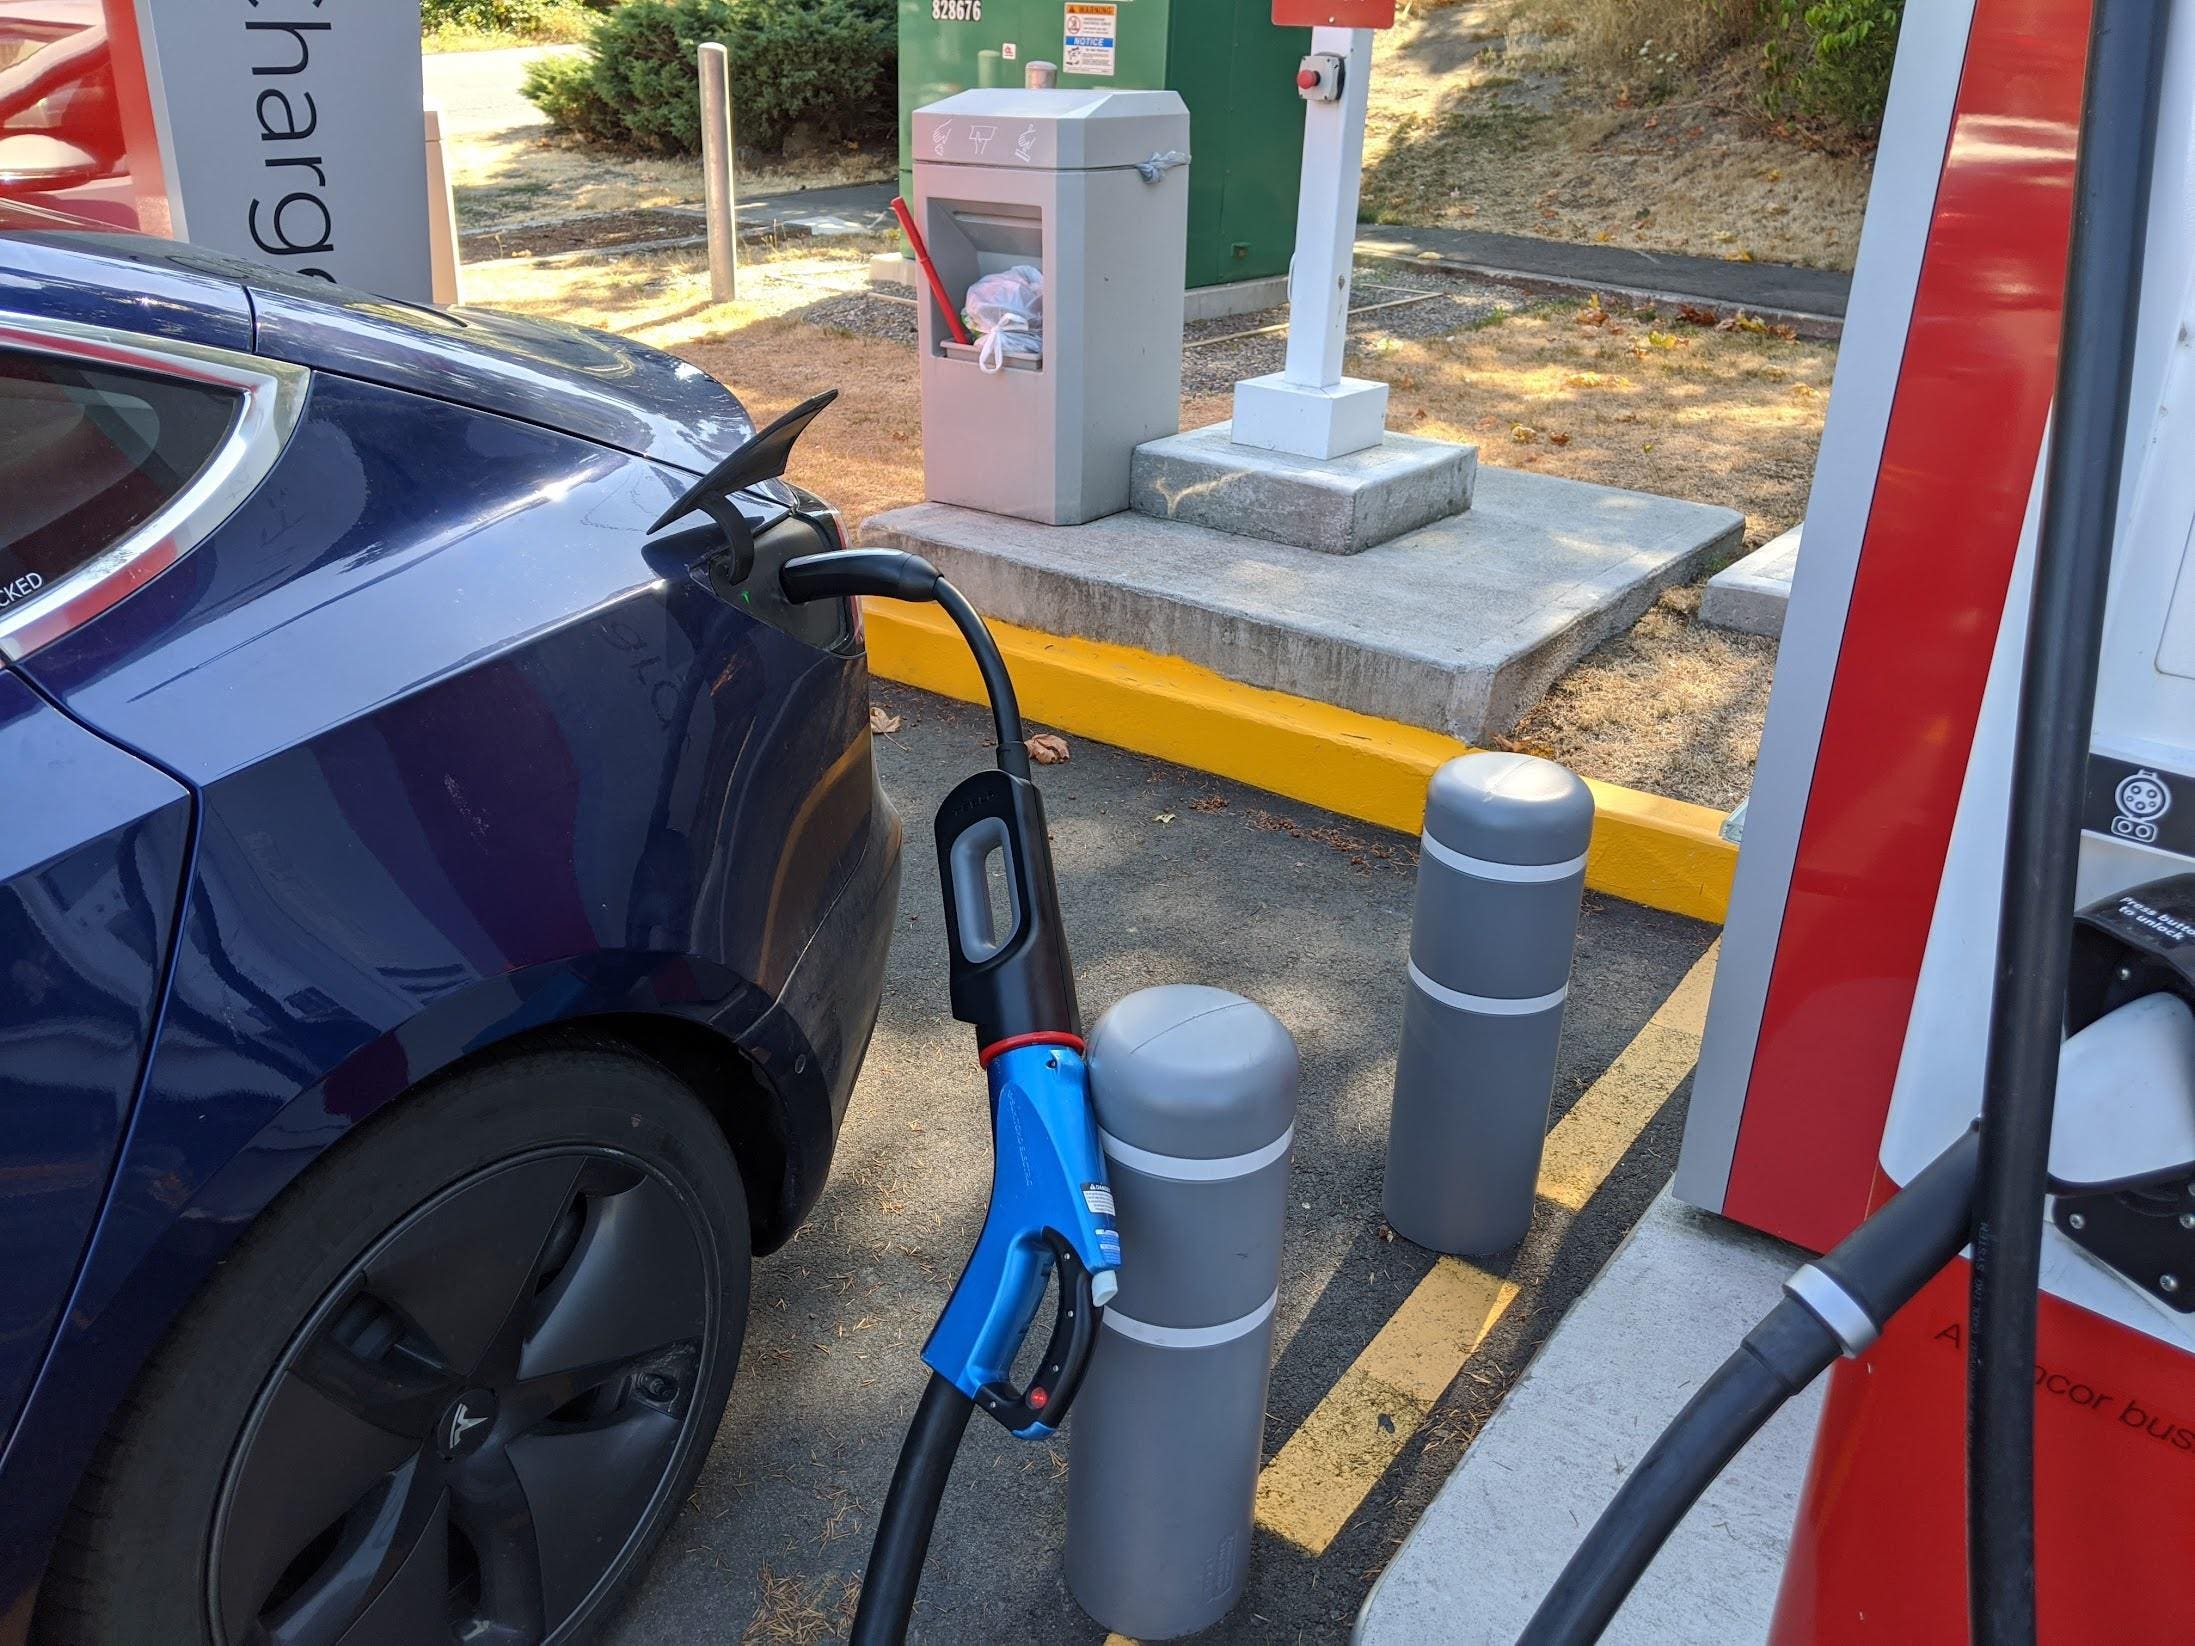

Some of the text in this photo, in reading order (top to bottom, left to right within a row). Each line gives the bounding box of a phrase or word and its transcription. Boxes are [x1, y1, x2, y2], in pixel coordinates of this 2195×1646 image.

[932, 0, 981, 21] 828676
[1073, 37, 1105, 47] NOTICE
[245, 0, 337, 284] harg
[2120, 896, 2158, 916] Press
[2119, 905, 2185, 940] to unlock
[1934, 1323, 1961, 1349] A
